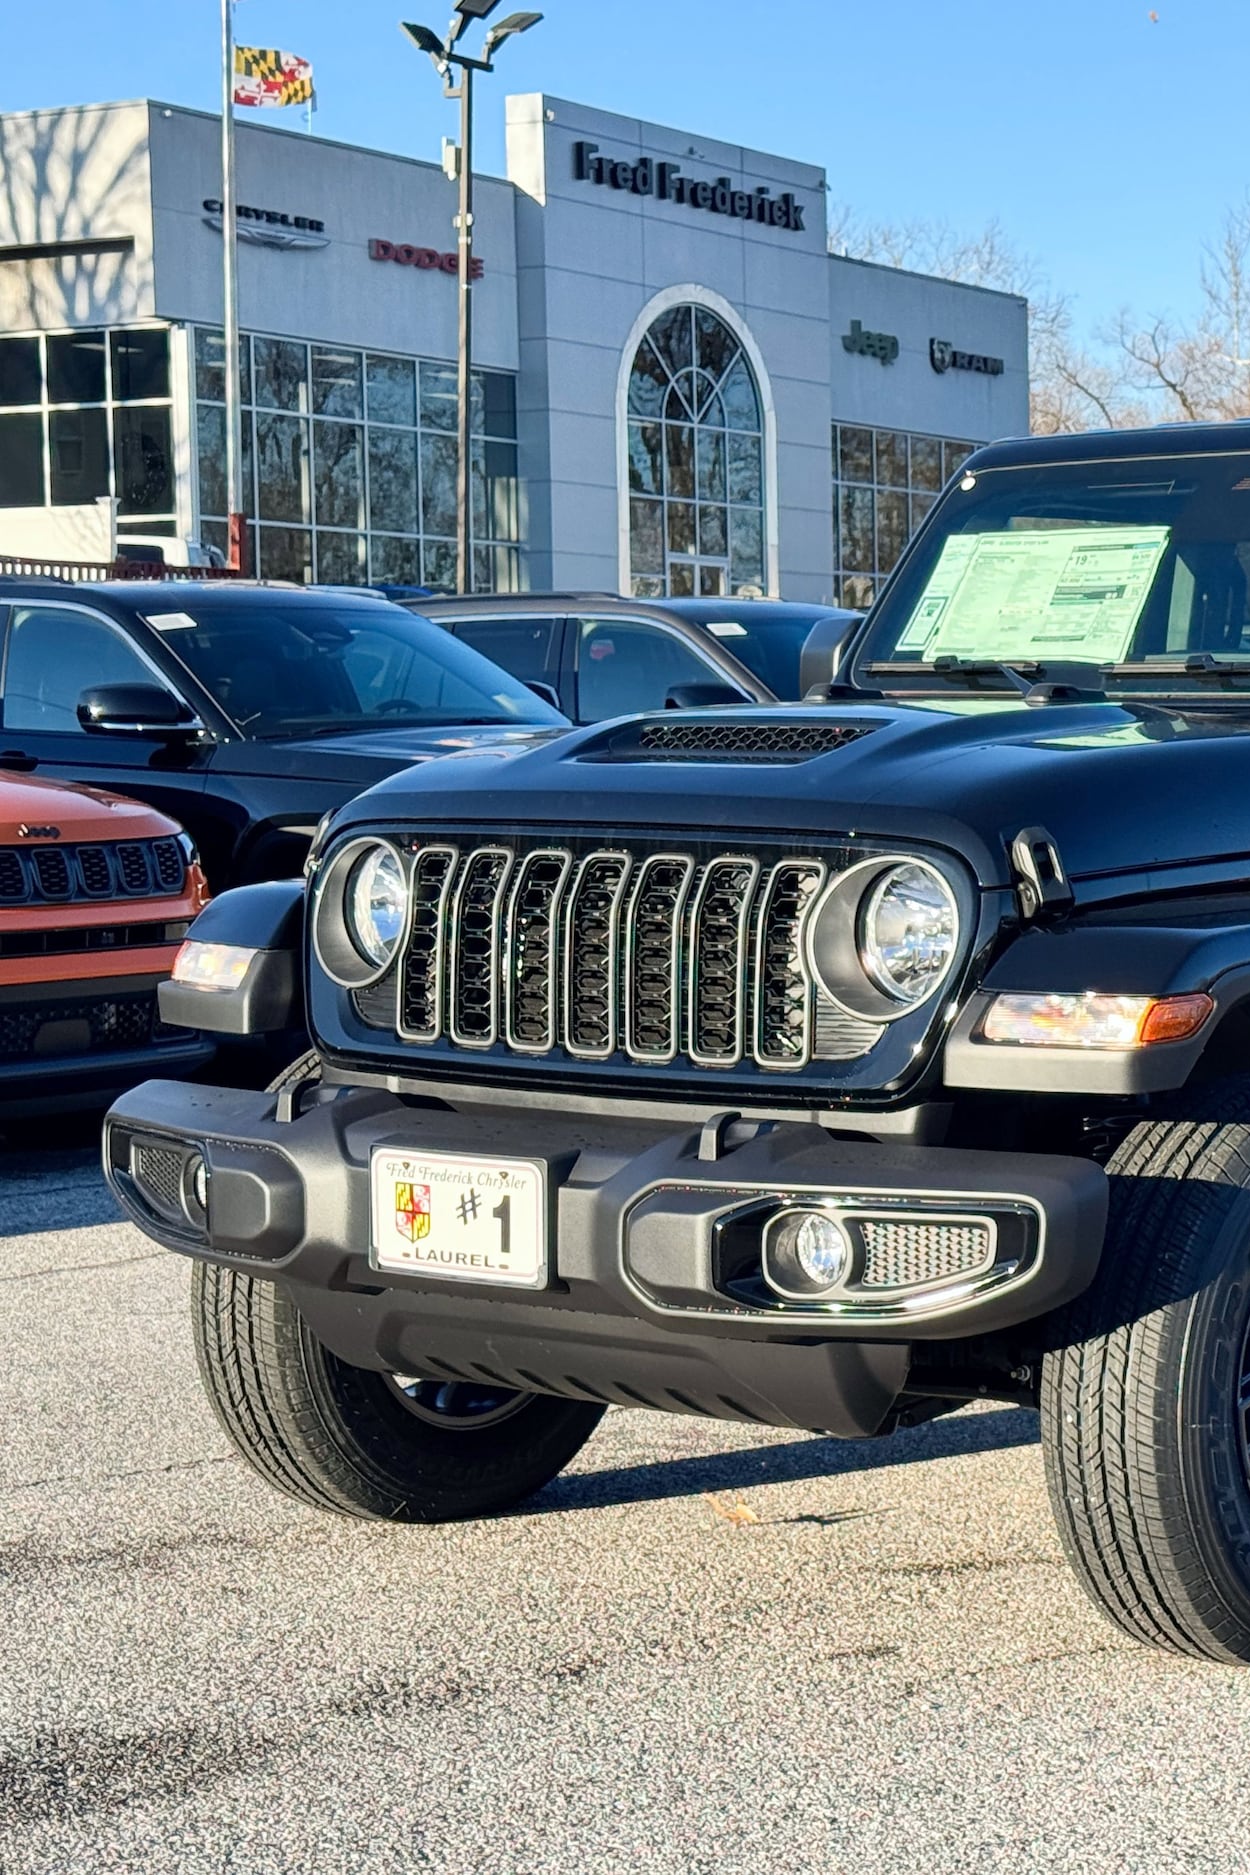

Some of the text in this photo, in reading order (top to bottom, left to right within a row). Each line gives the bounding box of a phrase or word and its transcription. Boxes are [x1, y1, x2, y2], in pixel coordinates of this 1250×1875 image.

[573, 141, 806, 231] Fred Frederick
[202, 199, 325, 232] CRYSLER
[841, 319, 899, 366] Jeep
[950, 350, 1004, 376] RAM
[386, 1161, 527, 1190] Fred Frederick Chrysler
[415, 1247, 495, 1268] LAUREL
